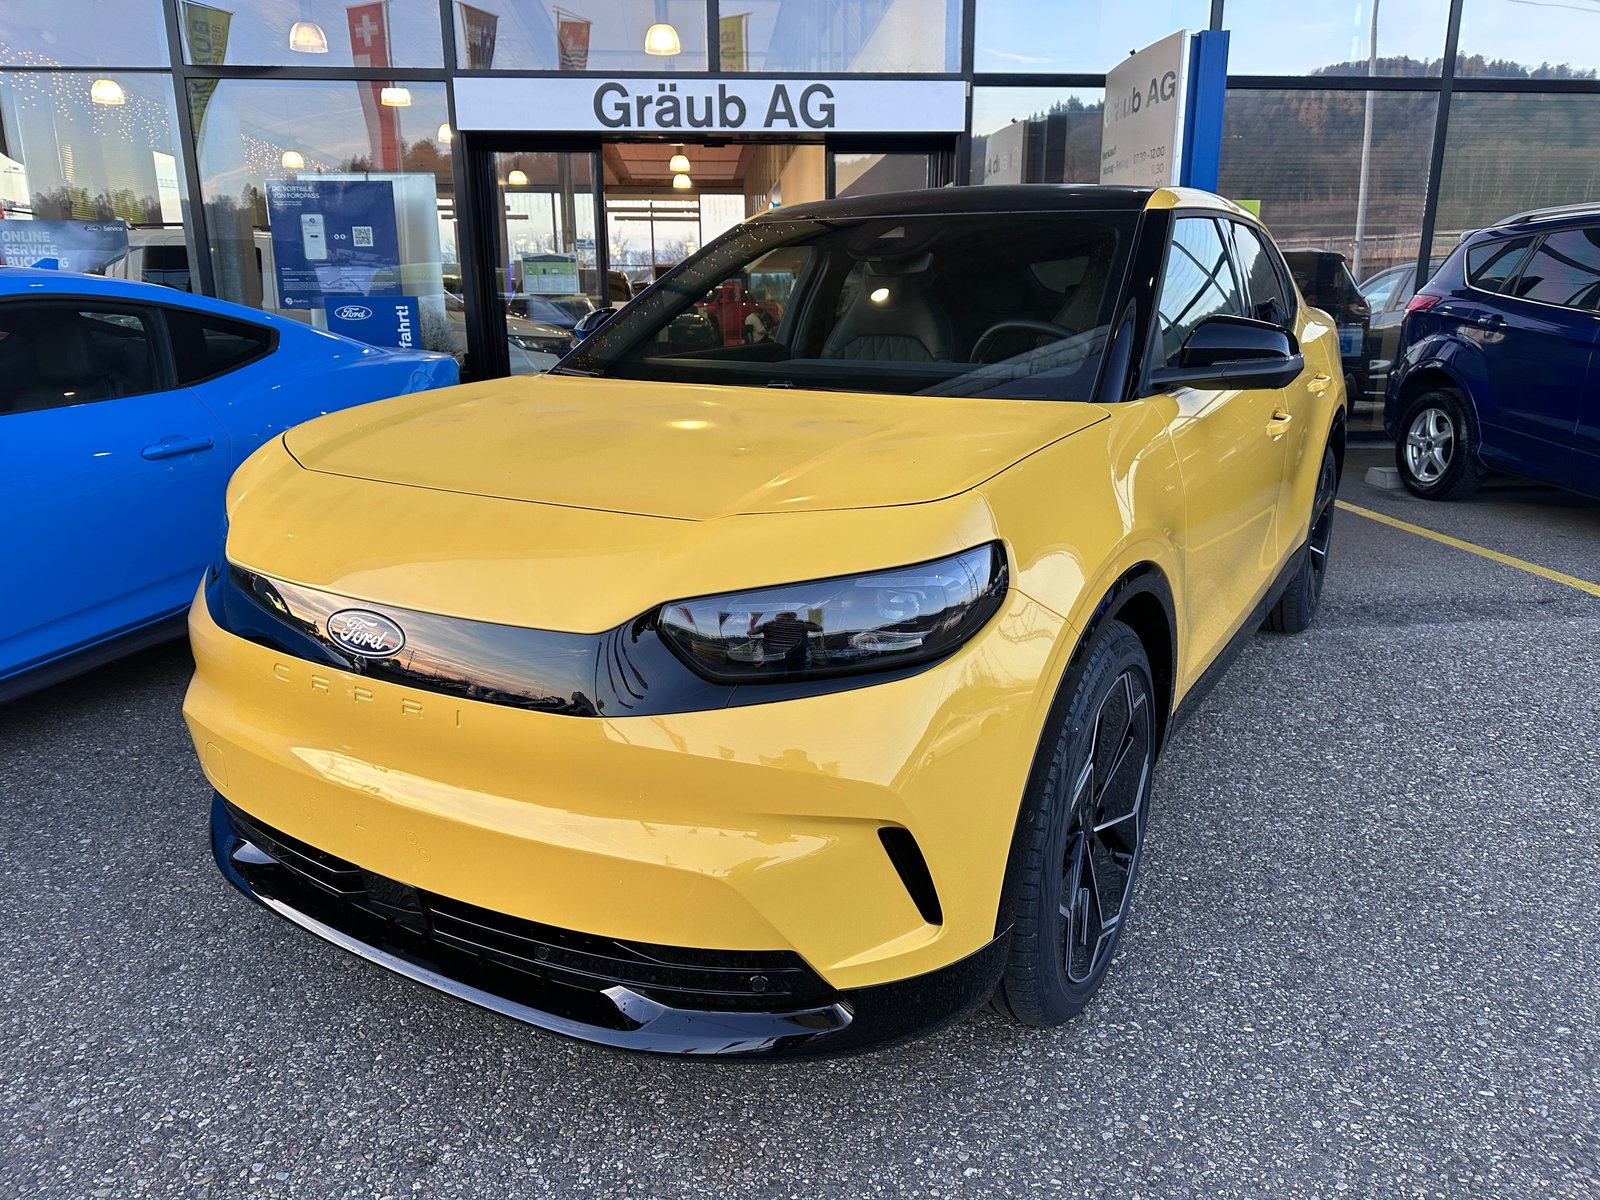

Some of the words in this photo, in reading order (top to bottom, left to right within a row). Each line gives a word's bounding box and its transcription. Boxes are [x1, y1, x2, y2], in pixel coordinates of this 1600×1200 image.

[1146, 70, 1176, 108] AG
[593, 81, 747, 128] Gräub
[763, 83, 836, 128] AG
[1150, 145, 1165, 159] 12.00
[1, 231, 51, 243] ONLINE
[4, 243, 59, 256] SERVICE
[273, 662, 462, 728] CAPRI
